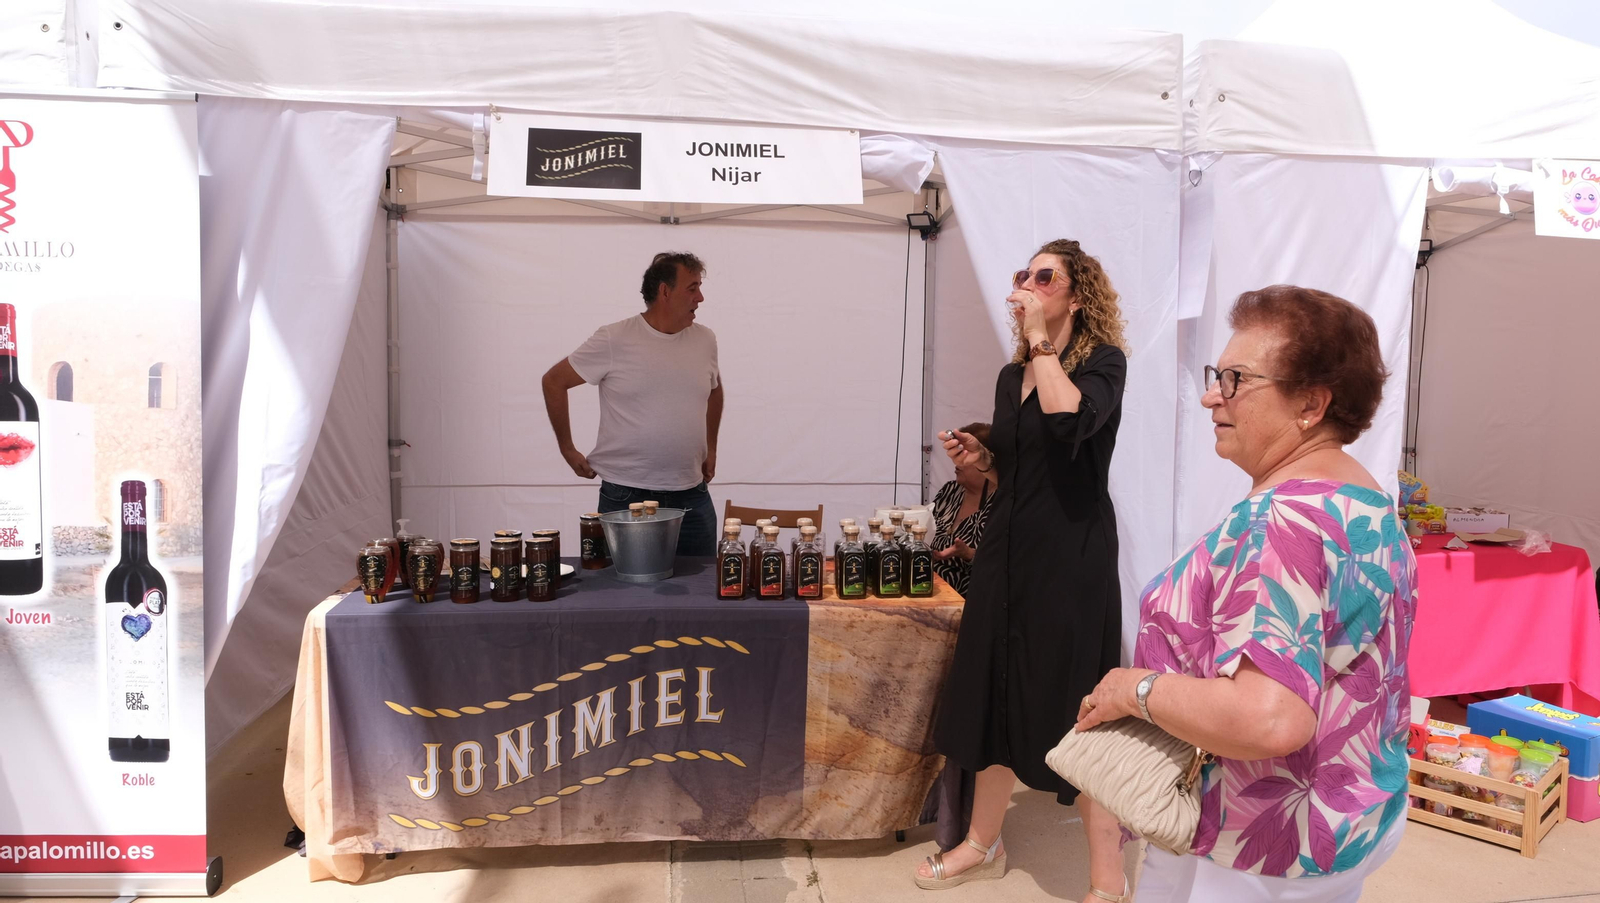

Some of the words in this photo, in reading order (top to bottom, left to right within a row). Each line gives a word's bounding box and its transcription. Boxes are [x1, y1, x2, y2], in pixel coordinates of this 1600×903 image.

[541, 144, 628, 172] JONIMIEL
[685, 141, 786, 159] JONIMIEL
[711, 166, 762, 186] Nijar
[123, 500, 143, 510] ESTÁ
[123, 509, 141, 518] POR
[123, 516, 146, 525] VENIR
[5, 608, 51, 625] Joven
[126, 690, 145, 699] ESTÁ
[405, 666, 726, 801] JONIMIEL
[121, 773, 156, 787] Roble
[0, 841, 155, 864] apalomillo.es
